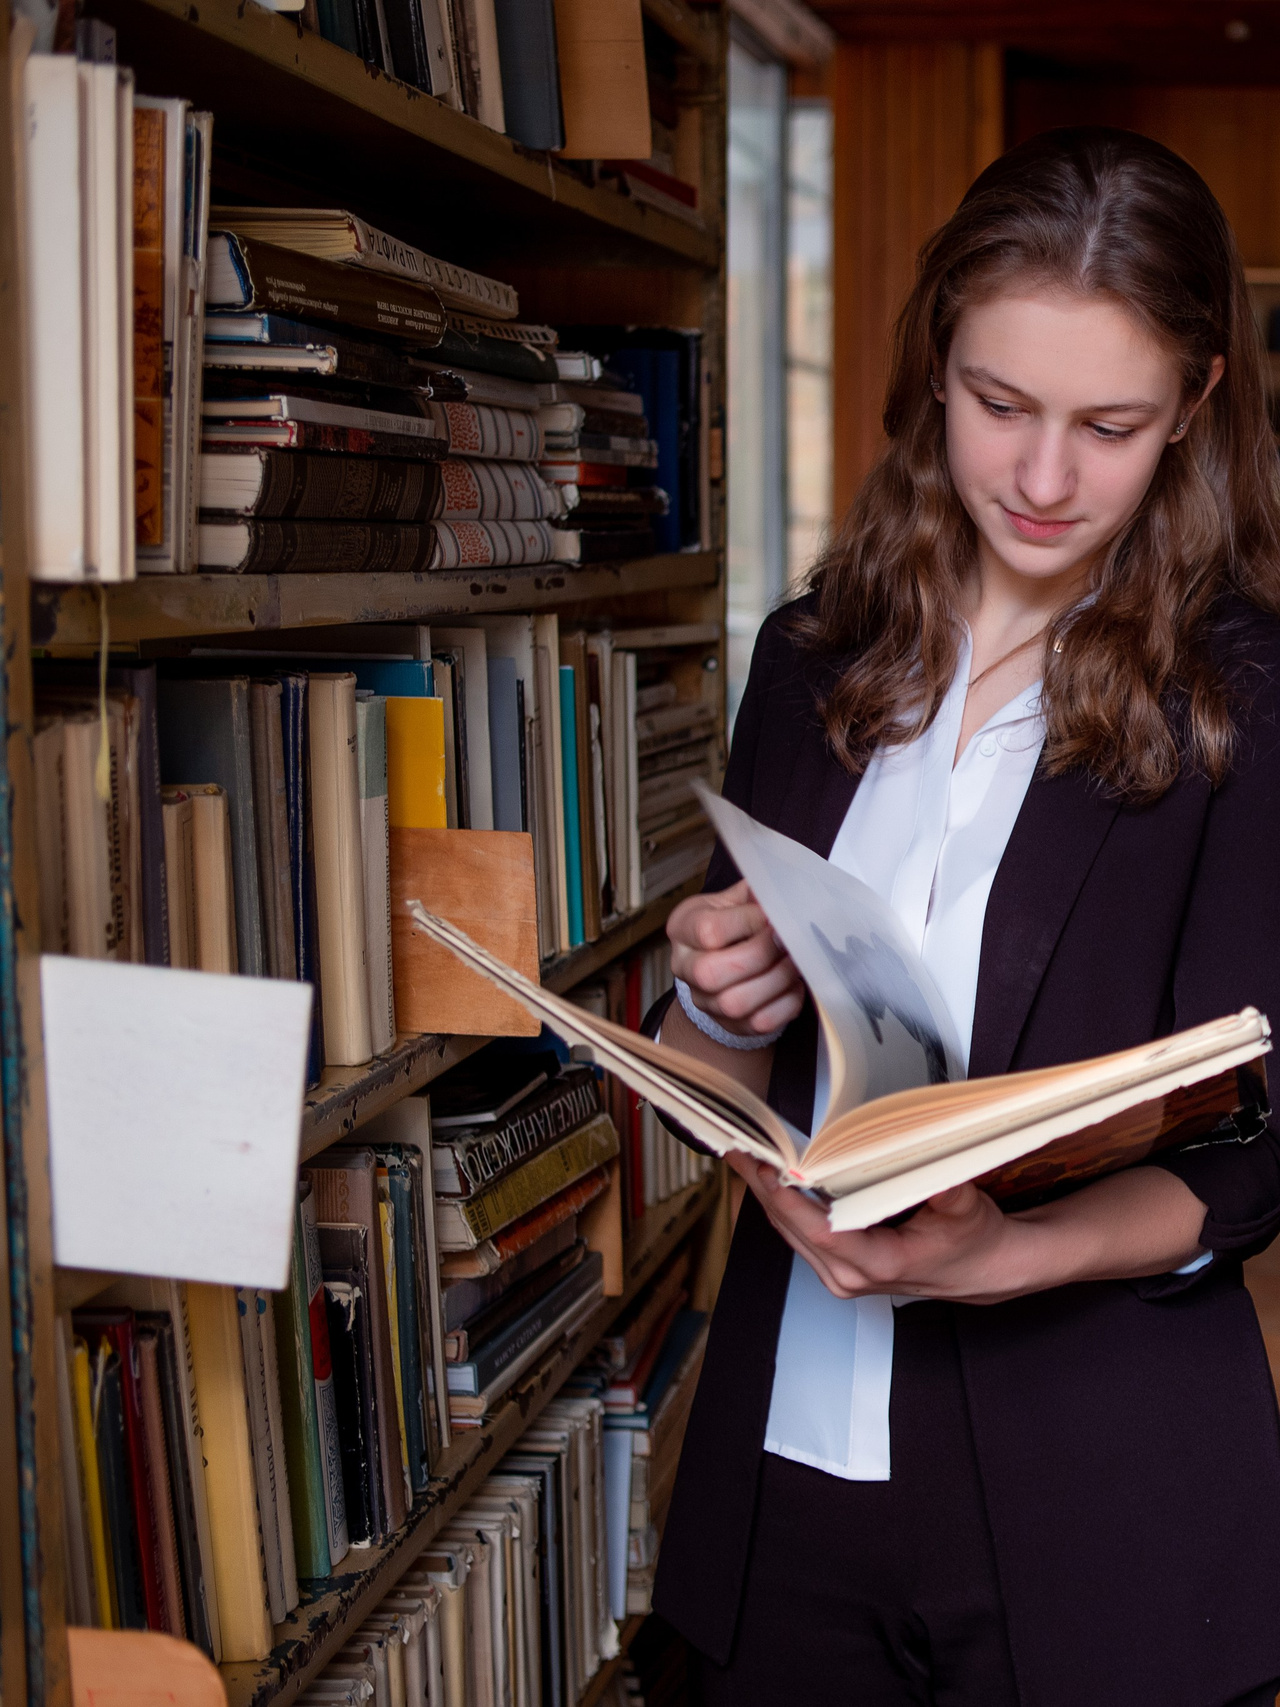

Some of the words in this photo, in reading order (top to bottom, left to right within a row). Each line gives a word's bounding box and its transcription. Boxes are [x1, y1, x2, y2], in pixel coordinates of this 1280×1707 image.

[367, 232, 418, 272] ШРИФТА
[422, 257, 514, 310] ИСКУССТВО
[466, 1081, 598, 1185] МИКЕЛАНДЖЕЛО
